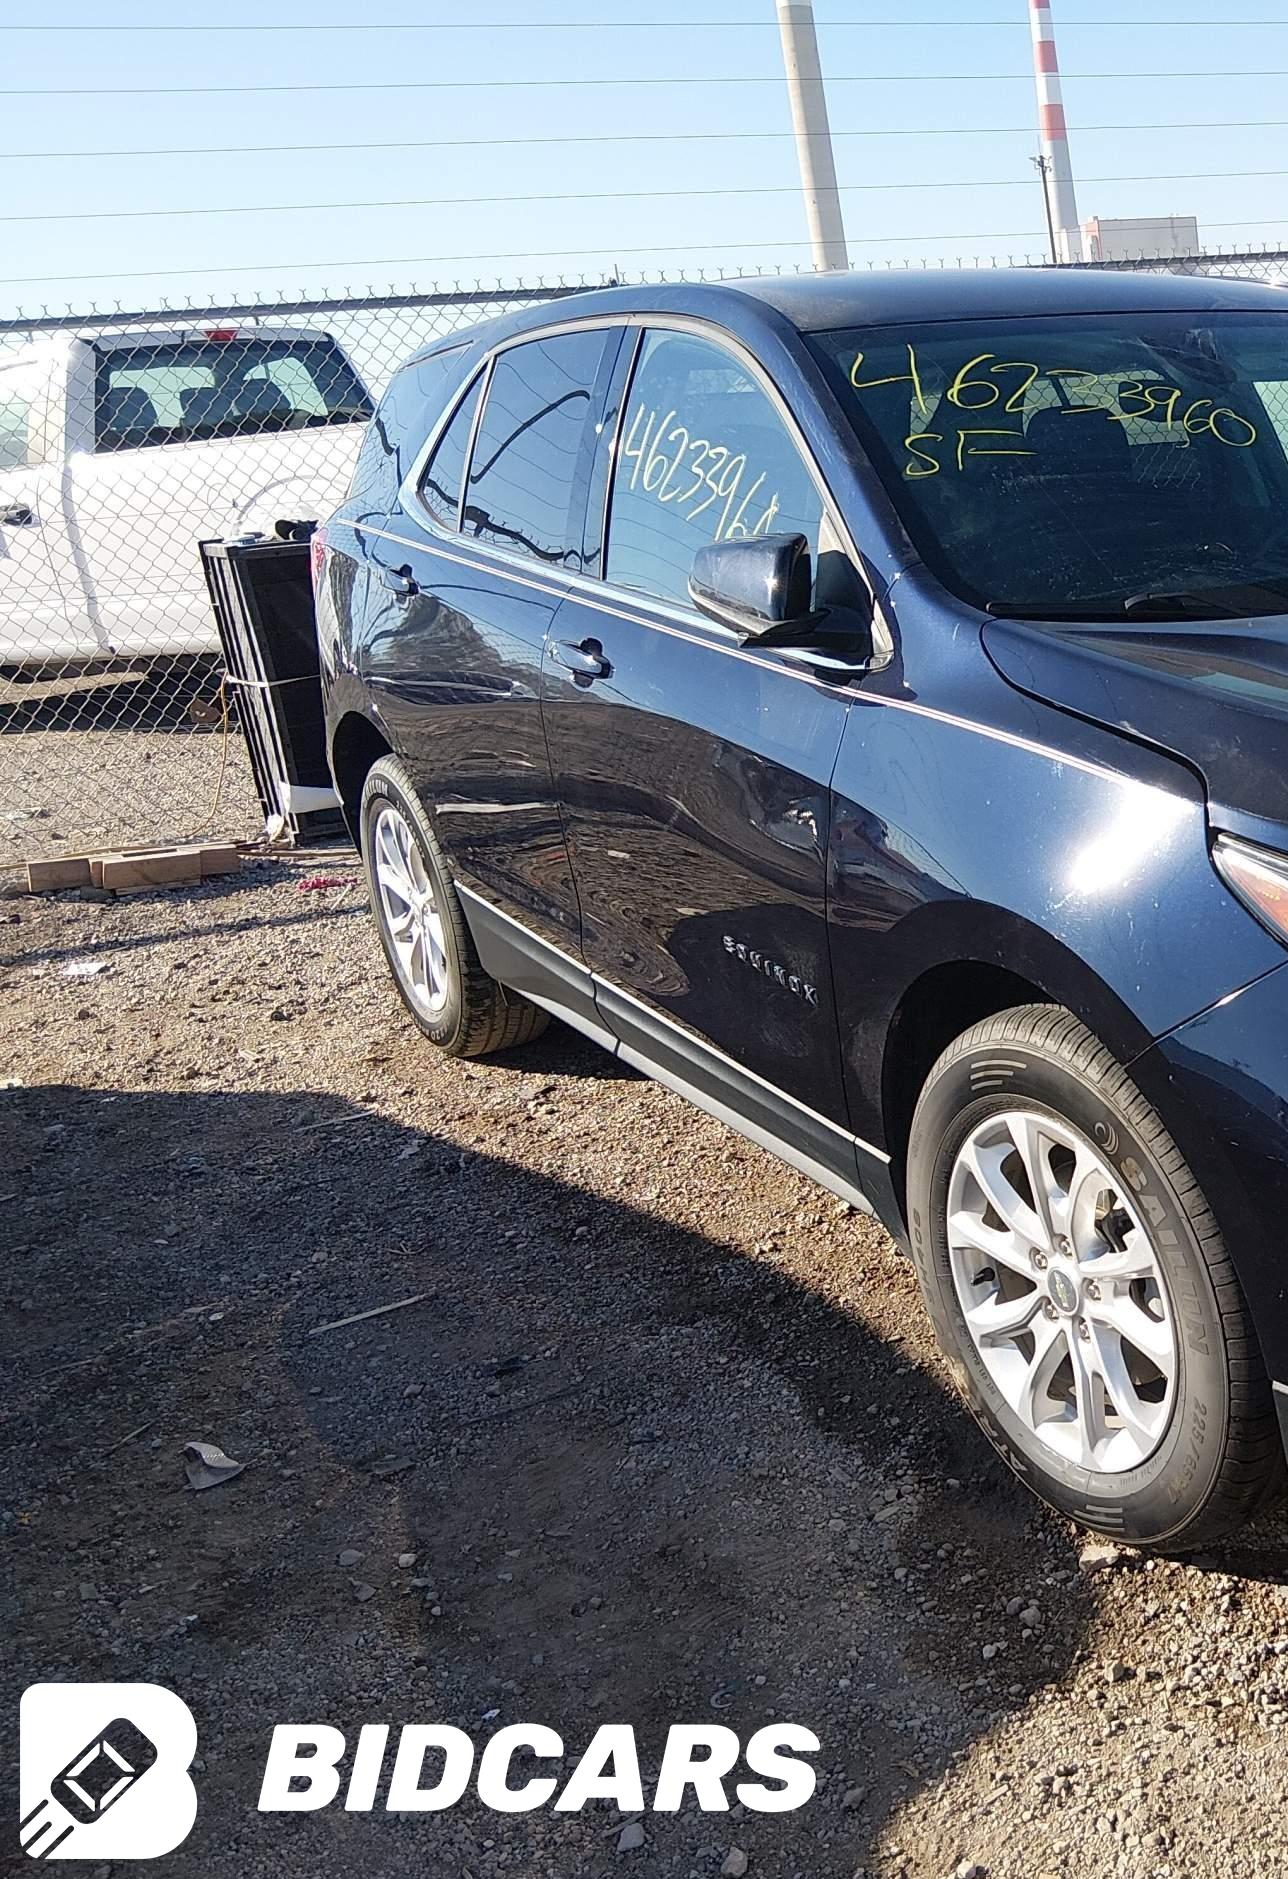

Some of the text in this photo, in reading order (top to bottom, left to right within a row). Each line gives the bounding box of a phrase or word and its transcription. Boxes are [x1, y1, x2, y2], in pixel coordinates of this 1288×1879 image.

[850, 343, 1257, 448] 46233960
[722, 934, 820, 1008] EQUINOX
[1119, 1155, 1211, 1357] SAILUN
